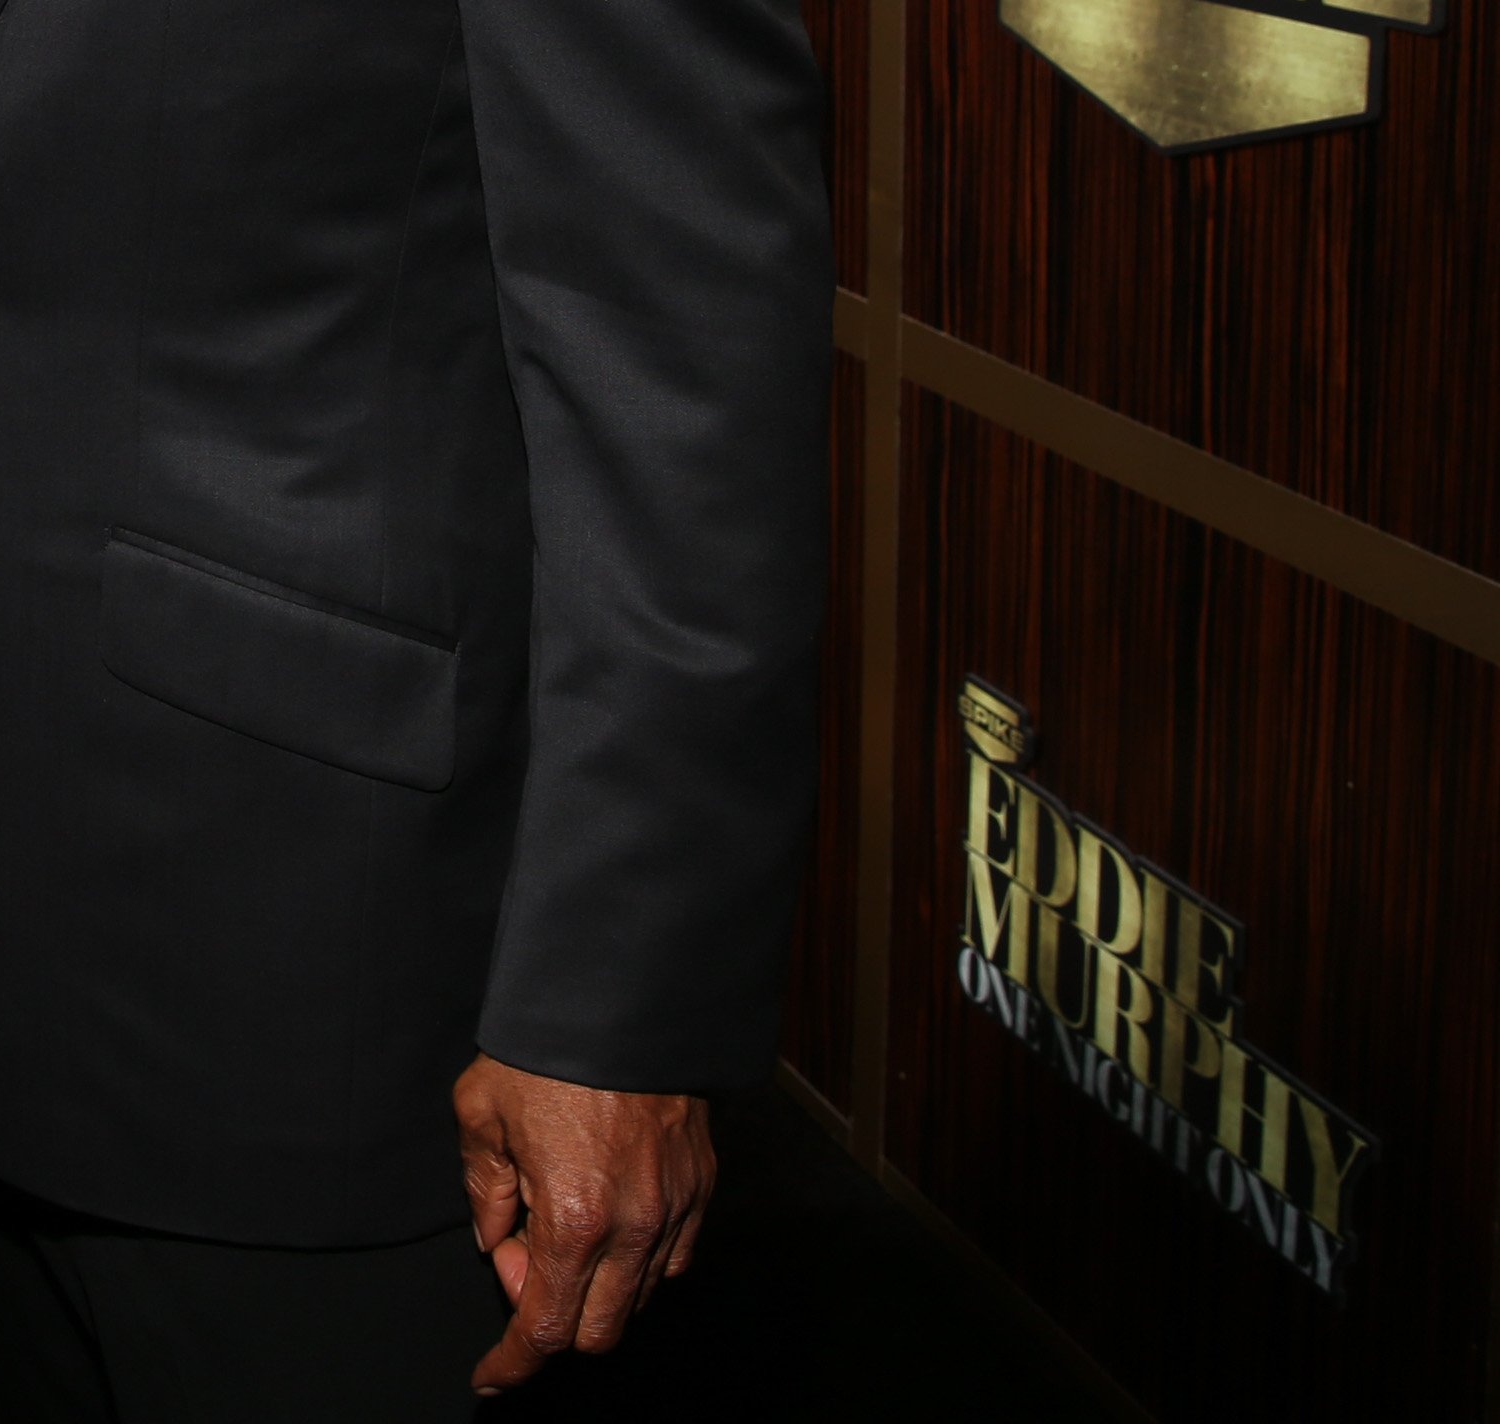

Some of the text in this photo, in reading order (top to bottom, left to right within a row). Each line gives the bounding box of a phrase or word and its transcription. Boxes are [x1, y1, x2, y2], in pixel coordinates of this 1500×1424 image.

[958, 694, 1025, 753] SPIKE
[961, 843, 1368, 1243] MURPHY
[963, 748, 1236, 1039] EDDIE
[957, 946, 1345, 1293] ONE NIGHT ONLY
